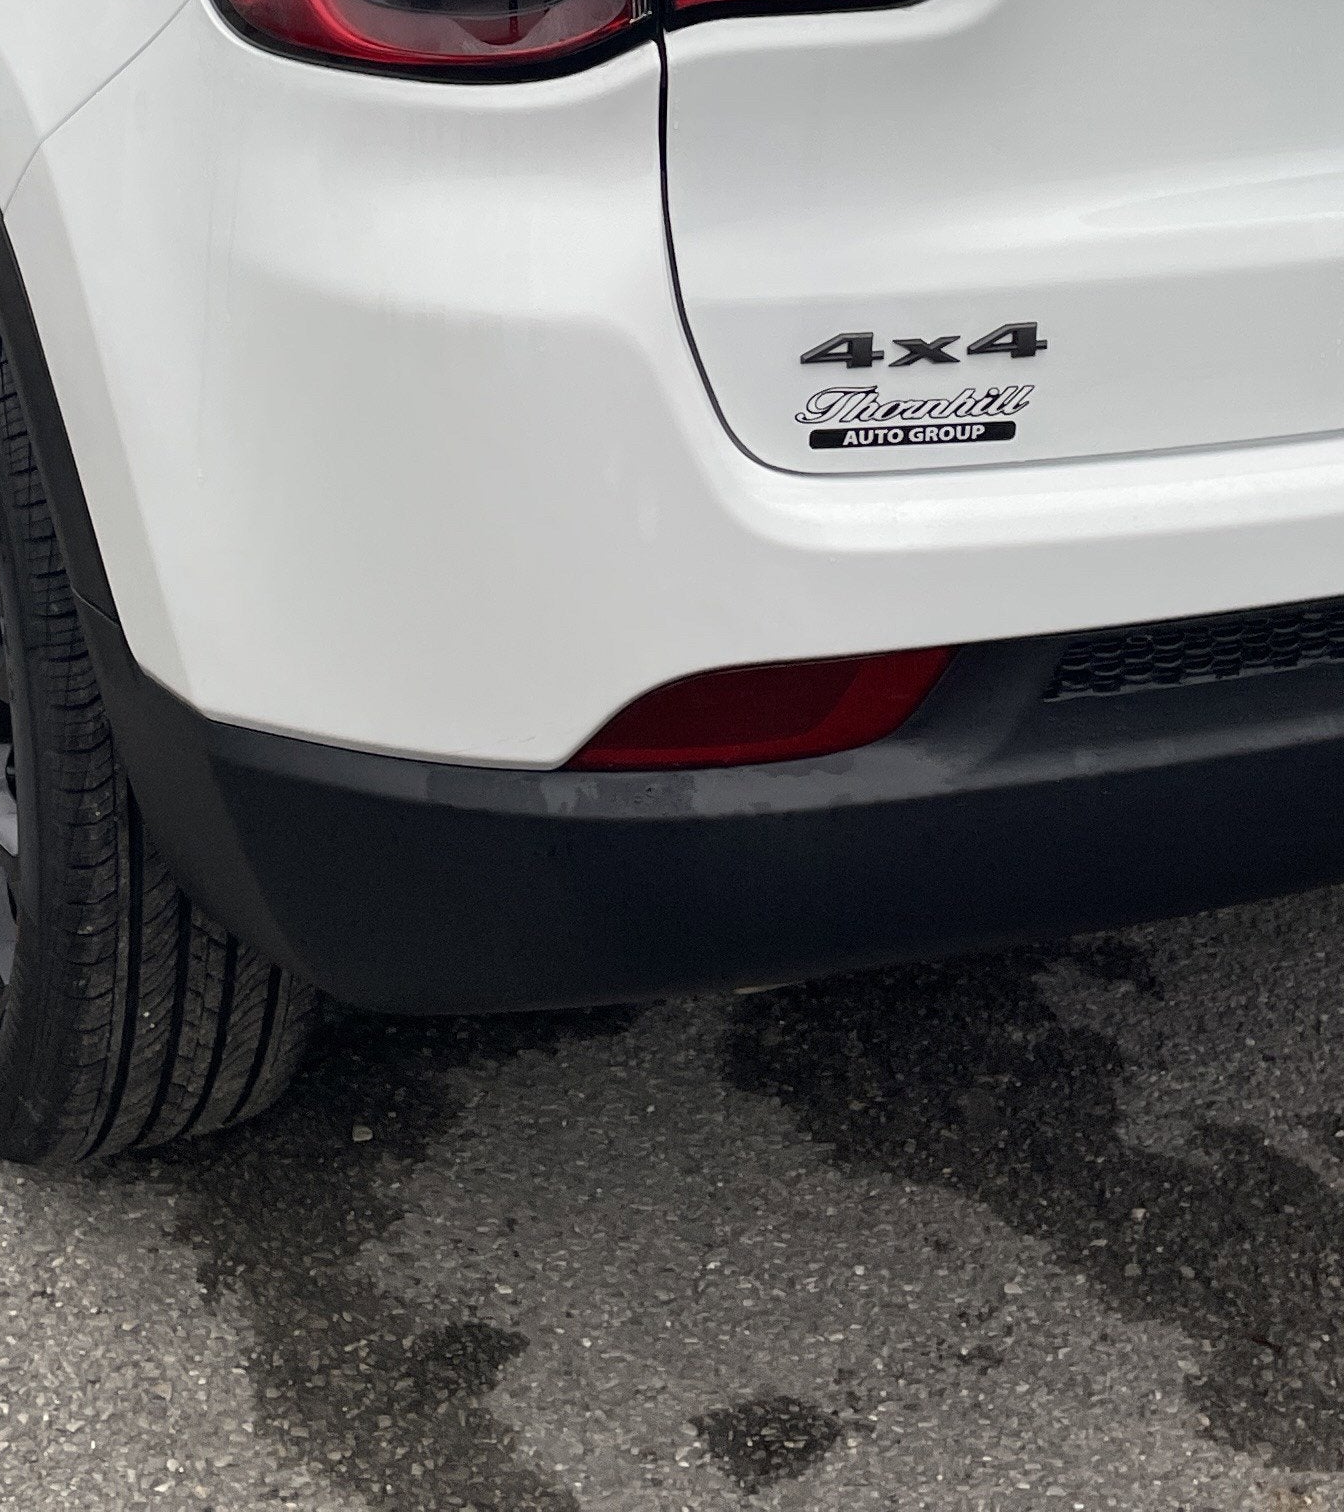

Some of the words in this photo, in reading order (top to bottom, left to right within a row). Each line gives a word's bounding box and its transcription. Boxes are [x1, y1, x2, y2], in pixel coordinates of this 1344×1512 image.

[800, 321, 1048, 369] 4x4
[794, 384, 1035, 424] Thornhill
[842, 428, 904, 446] AUTO
[907, 424, 985, 443] GROUP
